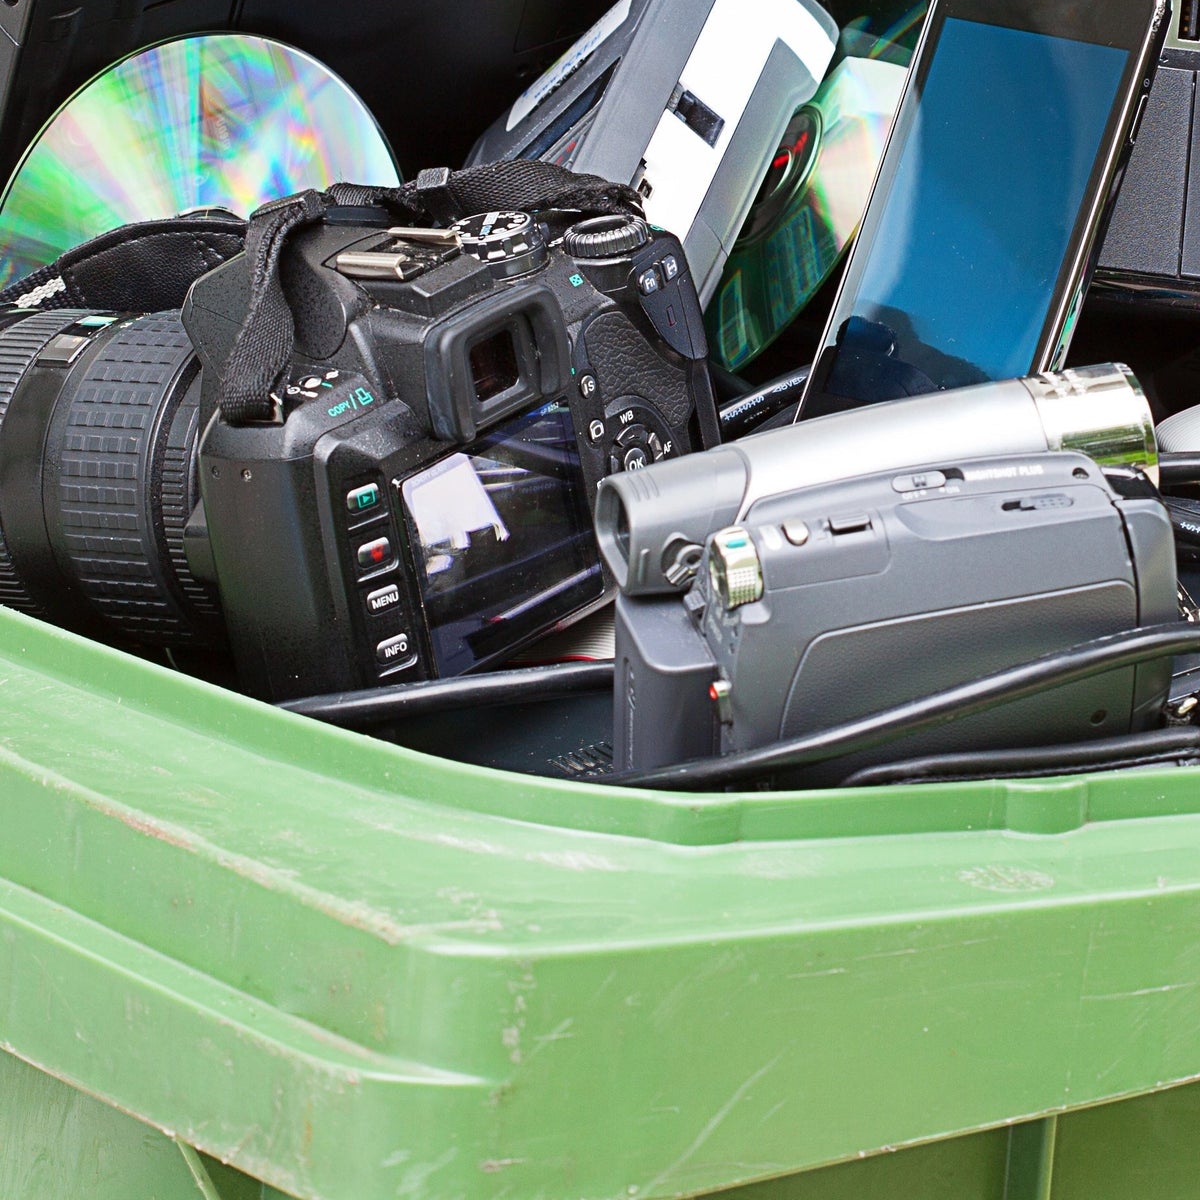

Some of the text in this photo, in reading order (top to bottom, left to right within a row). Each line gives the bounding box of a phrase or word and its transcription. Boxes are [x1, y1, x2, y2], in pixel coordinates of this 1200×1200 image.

[643, 276, 656, 289] Fn
[618, 409, 634, 424] WB
[662, 440, 673, 454] AF
[628, 457, 644, 471] OK
[1019, 463, 1044, 476] PLUS
[370, 590, 400, 609] MENU
[383, 640, 408, 658] INFO
